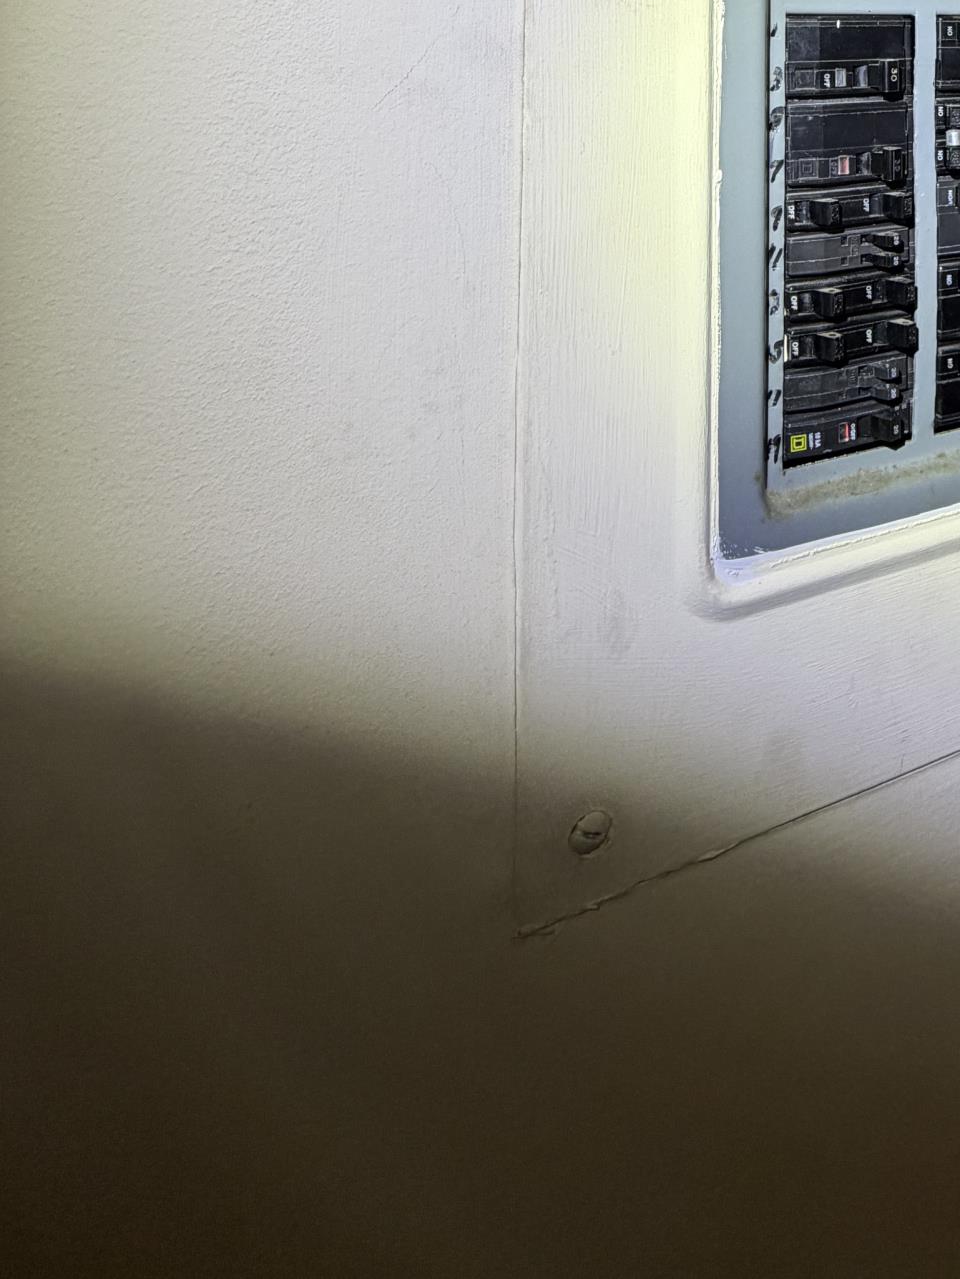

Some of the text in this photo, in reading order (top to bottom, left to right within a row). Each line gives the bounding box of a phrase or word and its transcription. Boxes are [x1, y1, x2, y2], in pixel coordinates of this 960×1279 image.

[946, 26, 953, 37] ON
[890, 67, 898, 82] 30
[823, 73, 831, 88] OFF
[937, 106, 944, 117] ON
[937, 150, 944, 161] ON
[788, 205, 796, 220] OFF
[893, 235, 900, 246] 20
[893, 256, 900, 266] 20
[946, 274, 953, 286] ON
[947, 357, 954, 370] ON
[890, 367, 897, 378] 20
[890, 388, 897, 399] 20
[893, 425, 899, 435] 20
